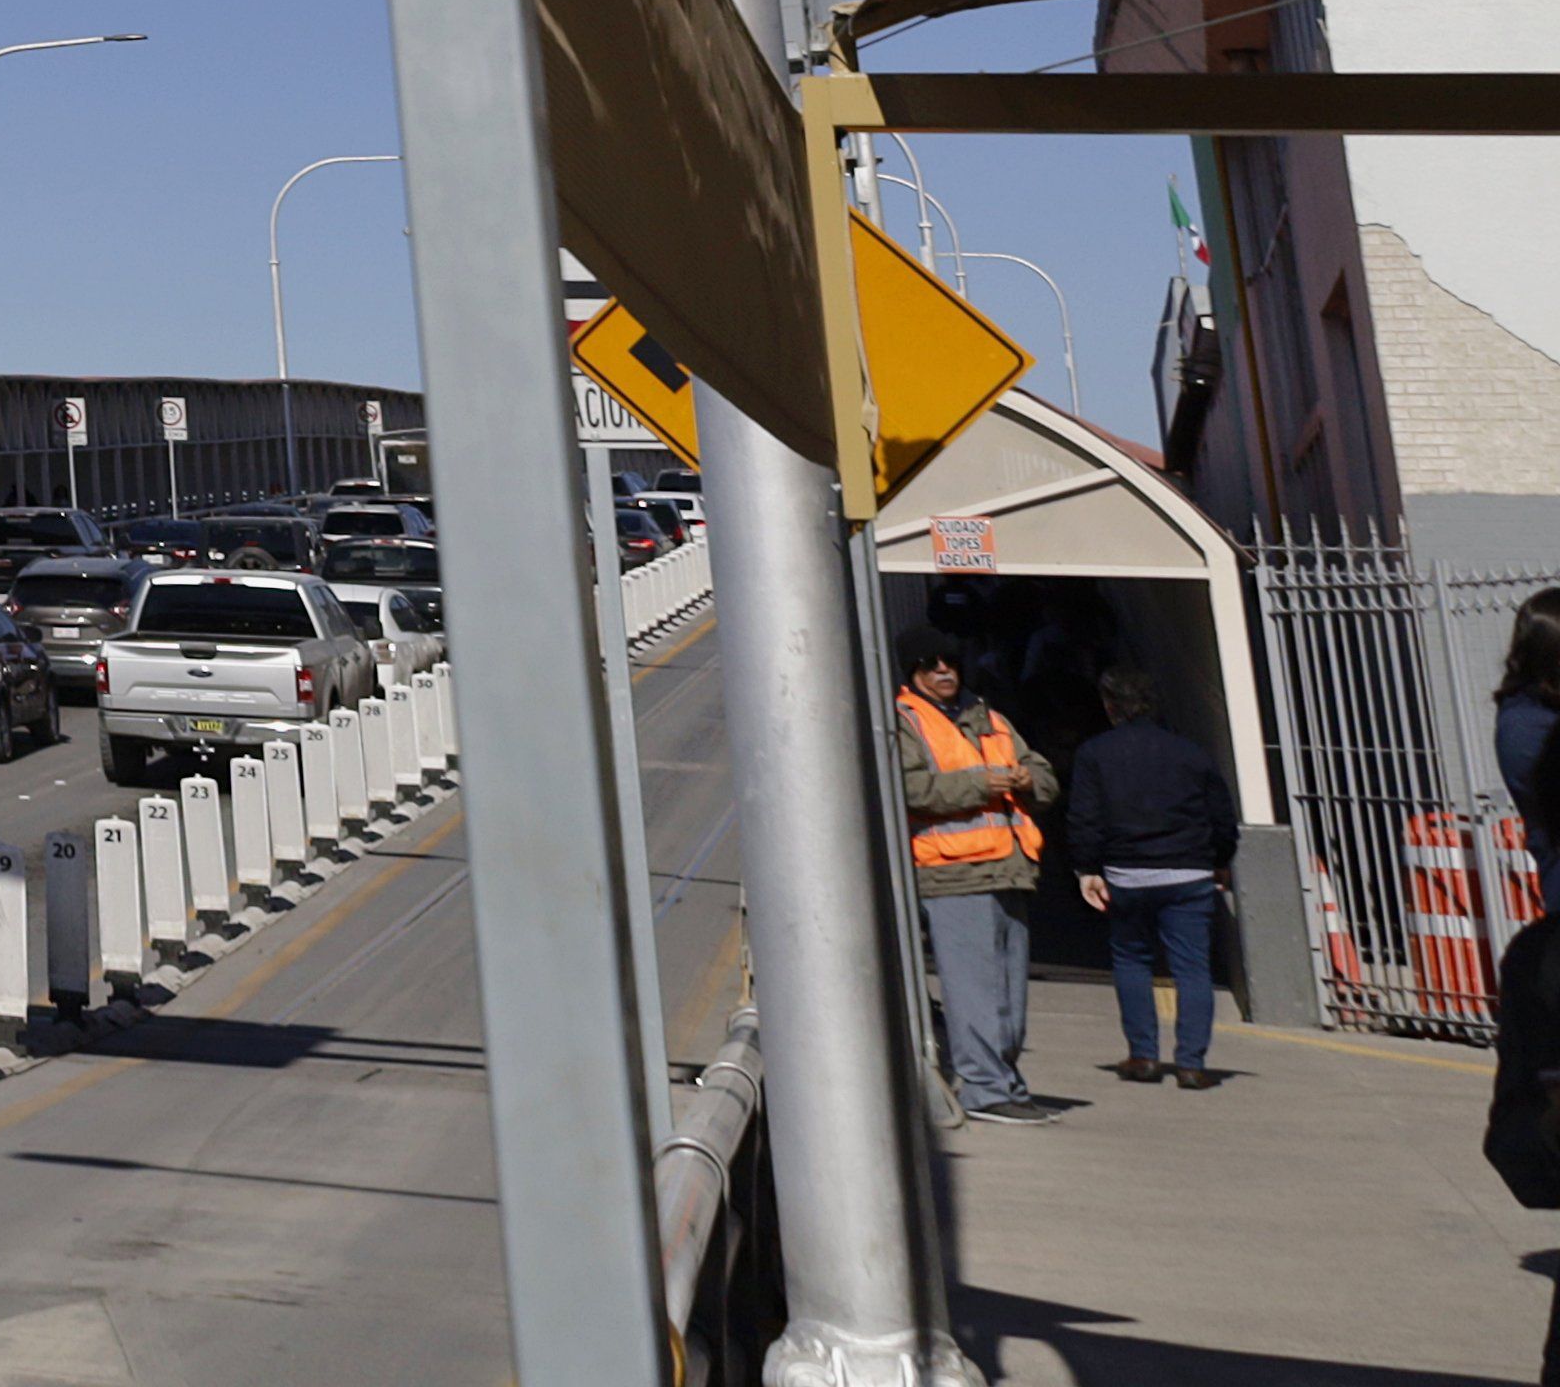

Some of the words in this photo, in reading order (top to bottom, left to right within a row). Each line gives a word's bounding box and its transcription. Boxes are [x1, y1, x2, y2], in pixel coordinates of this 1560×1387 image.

[936, 520, 986, 533] CUIDADO
[946, 537, 981, 550] TOPES
[938, 553, 993, 569] ADELANTE
[392, 691, 408, 702] 29
[335, 717, 352, 728] 27
[306, 729, 324, 741] 26
[271, 748, 289, 761] 25
[237, 765, 257, 779] 24
[190, 785, 209, 800] 23
[148, 805, 169, 820] 22
[103, 828, 122, 843] 21
[52, 842, 76, 859] 20
